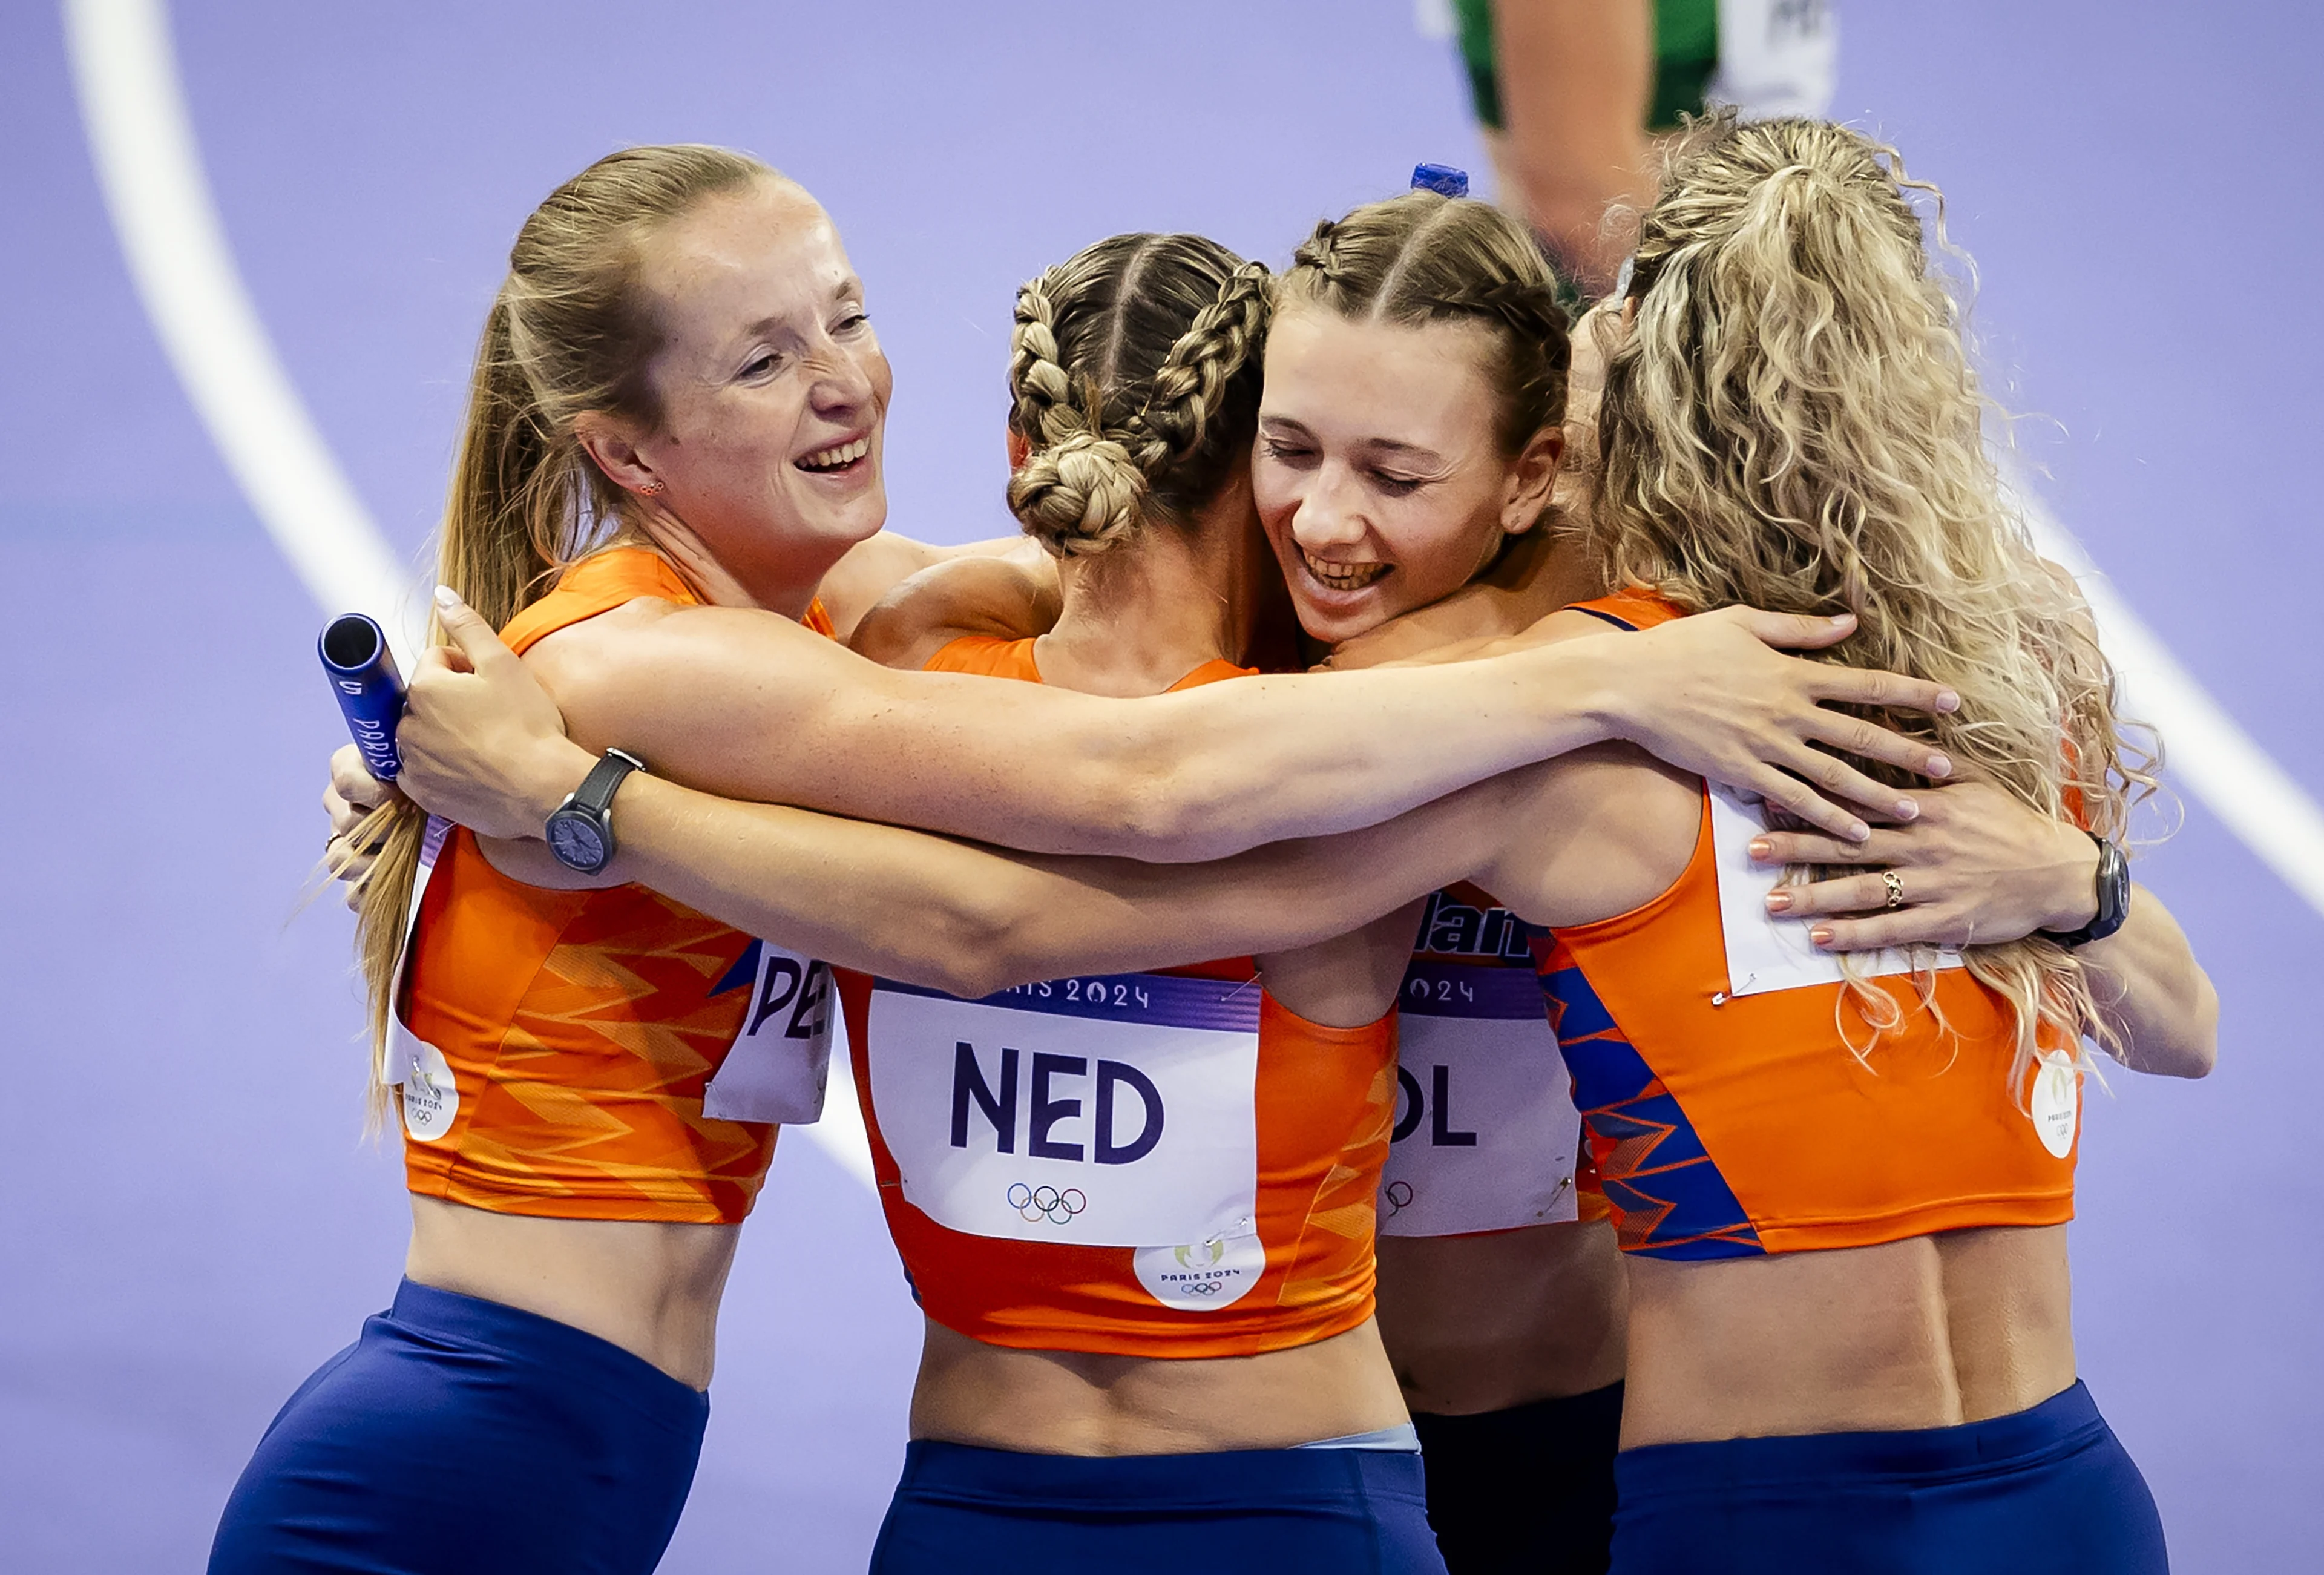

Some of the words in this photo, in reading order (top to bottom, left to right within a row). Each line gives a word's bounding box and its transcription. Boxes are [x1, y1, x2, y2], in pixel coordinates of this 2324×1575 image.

[1066, 979, 1149, 1008] 2024
[1399, 978, 1473, 1002] 024
[950, 1041, 1164, 1165] NED
[1206, 1269, 1240, 1279] 2024
